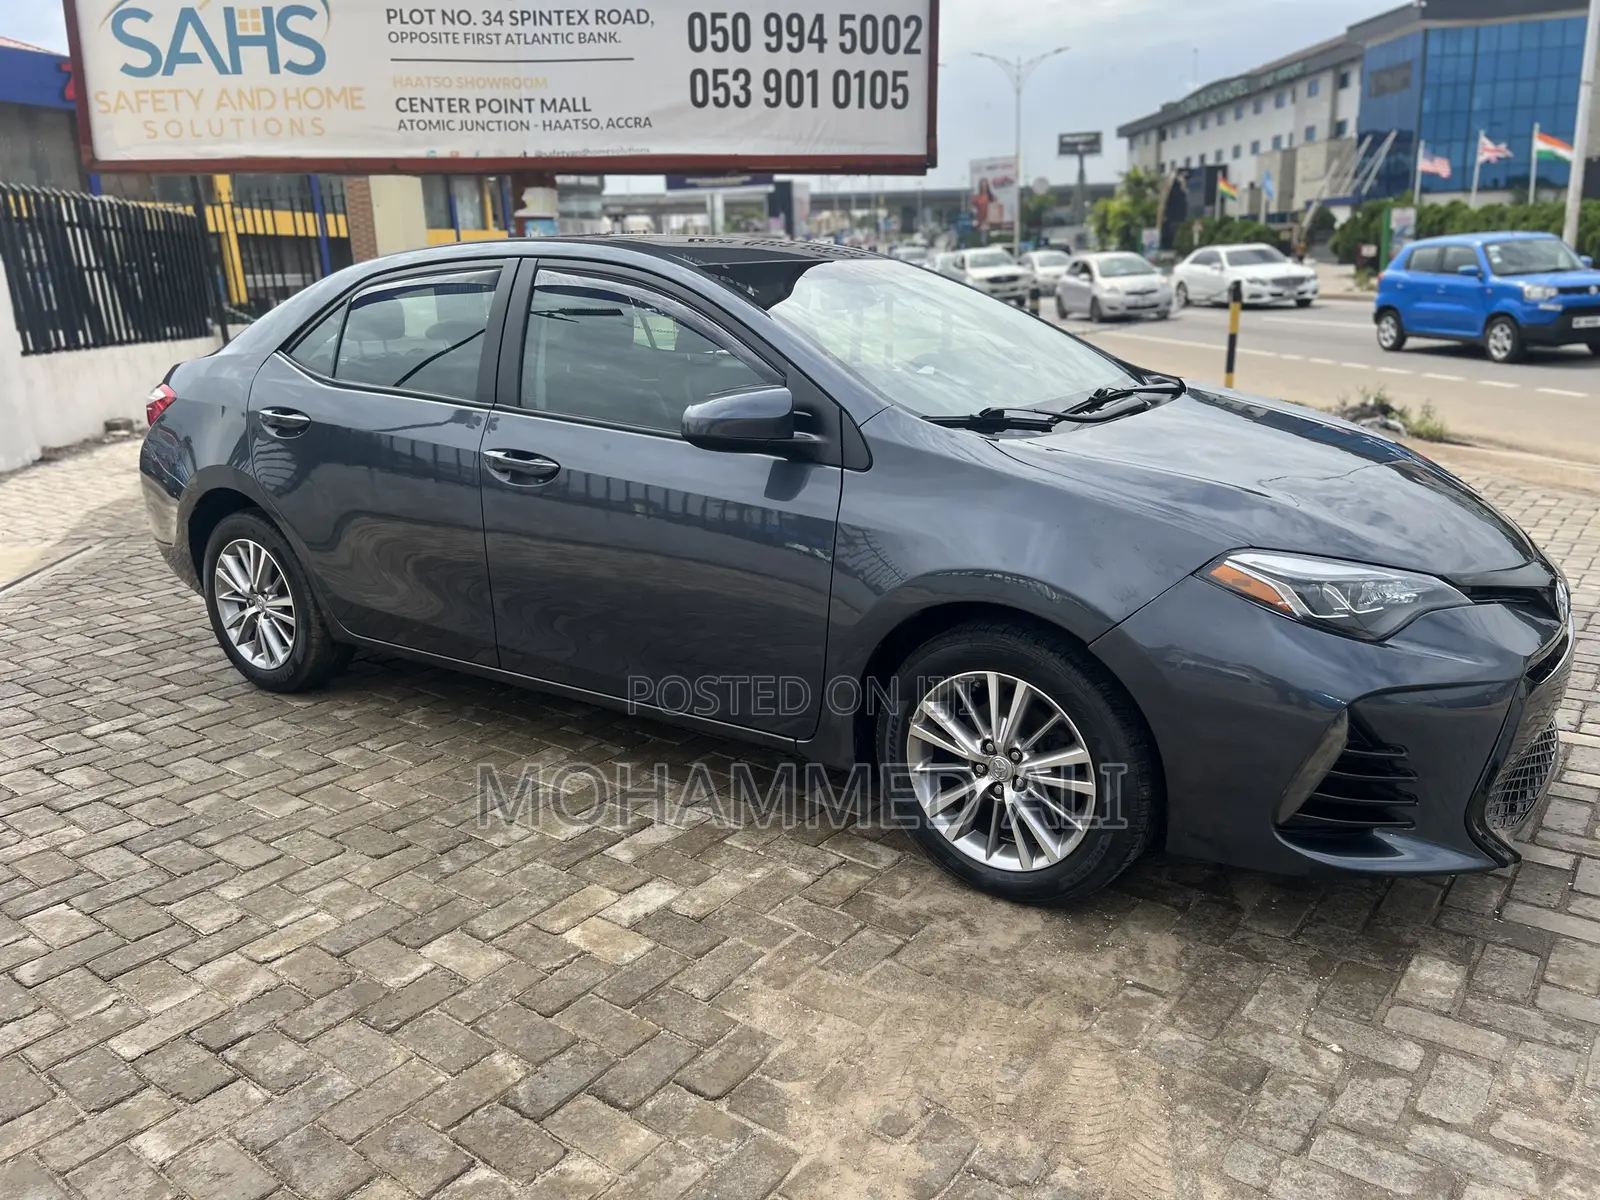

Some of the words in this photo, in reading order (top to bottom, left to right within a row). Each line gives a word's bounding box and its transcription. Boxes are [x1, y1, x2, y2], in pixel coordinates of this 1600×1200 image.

[386, 8, 436, 25] PLOT
[441, 9, 477, 26] NO.
[481, 10, 504, 26] 34
[509, 9, 590, 26] SPINTEX
[595, 8, 655, 27] ROAD,
[111, 5, 326, 78] SAHS
[388, 31, 460, 44] OPPOSITE
[463, 32, 501, 45] FIRST
[504, 32, 576, 45] ATLANTIC
[578, 31, 621, 44] BANK.
[687, 11, 751, 53] 050
[763, 12, 828, 54] 994
[838, 14, 923, 55] 5002
[392, 75, 454, 89] HAATSO
[456, 76, 548, 89] SHOWROOM
[690, 68, 752, 109] 053
[763, 68, 819, 109] 901
[832, 69, 909, 110] 0105
[94, 88, 205, 115] SAFETY
[215, 87, 277, 112] AND
[282, 86, 366, 111] HOME
[395, 97, 470, 114] CENTER
[476, 98, 535, 114] POINT
[540, 96, 592, 113] MALL
[143, 117, 326, 139] SOLUTIONS
[397, 118, 455, 132] ATOMIC
[458, 119, 531, 132] JUNCTION
[542, 118, 604, 131] HAATSO,
[606, 117, 652, 130] ACCRA
